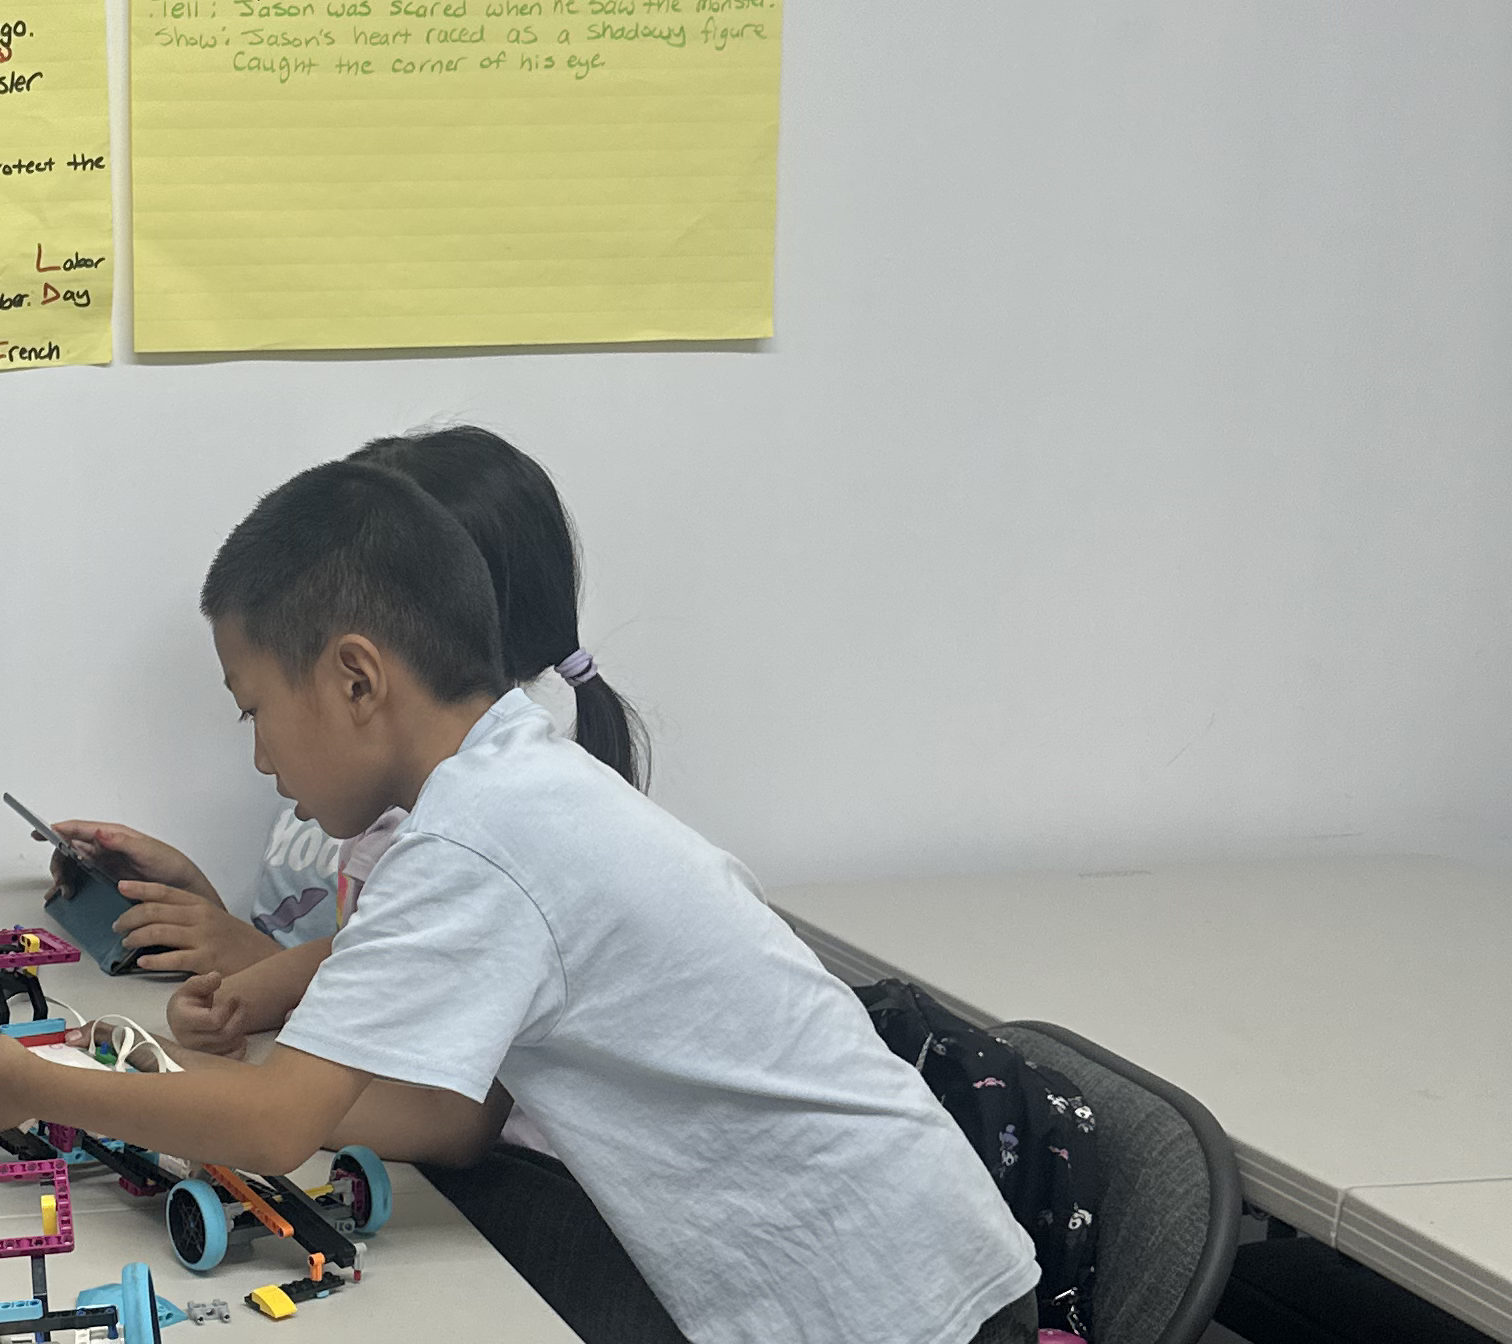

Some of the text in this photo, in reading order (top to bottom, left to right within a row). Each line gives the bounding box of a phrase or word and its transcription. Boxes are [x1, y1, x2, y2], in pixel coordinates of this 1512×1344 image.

[234, 0, 314, 18] Jason
[327, 0, 371, 18] was
[486, 0, 542, 18] when
[354, 27, 412, 46] heart
[426, 25, 485, 44] raced
[507, 26, 538, 44] as
[558, 29, 570, 44] a
[701, 16, 767, 51] figure
[335, 58, 374, 75] the
[392, 57, 466, 74] corner
[480, 51, 506, 69] of
[520, 53, 555, 71] his
[66, 153, 106, 171] the
[35, 243, 105, 273] Labor
[41, 282, 91, 308] Day
